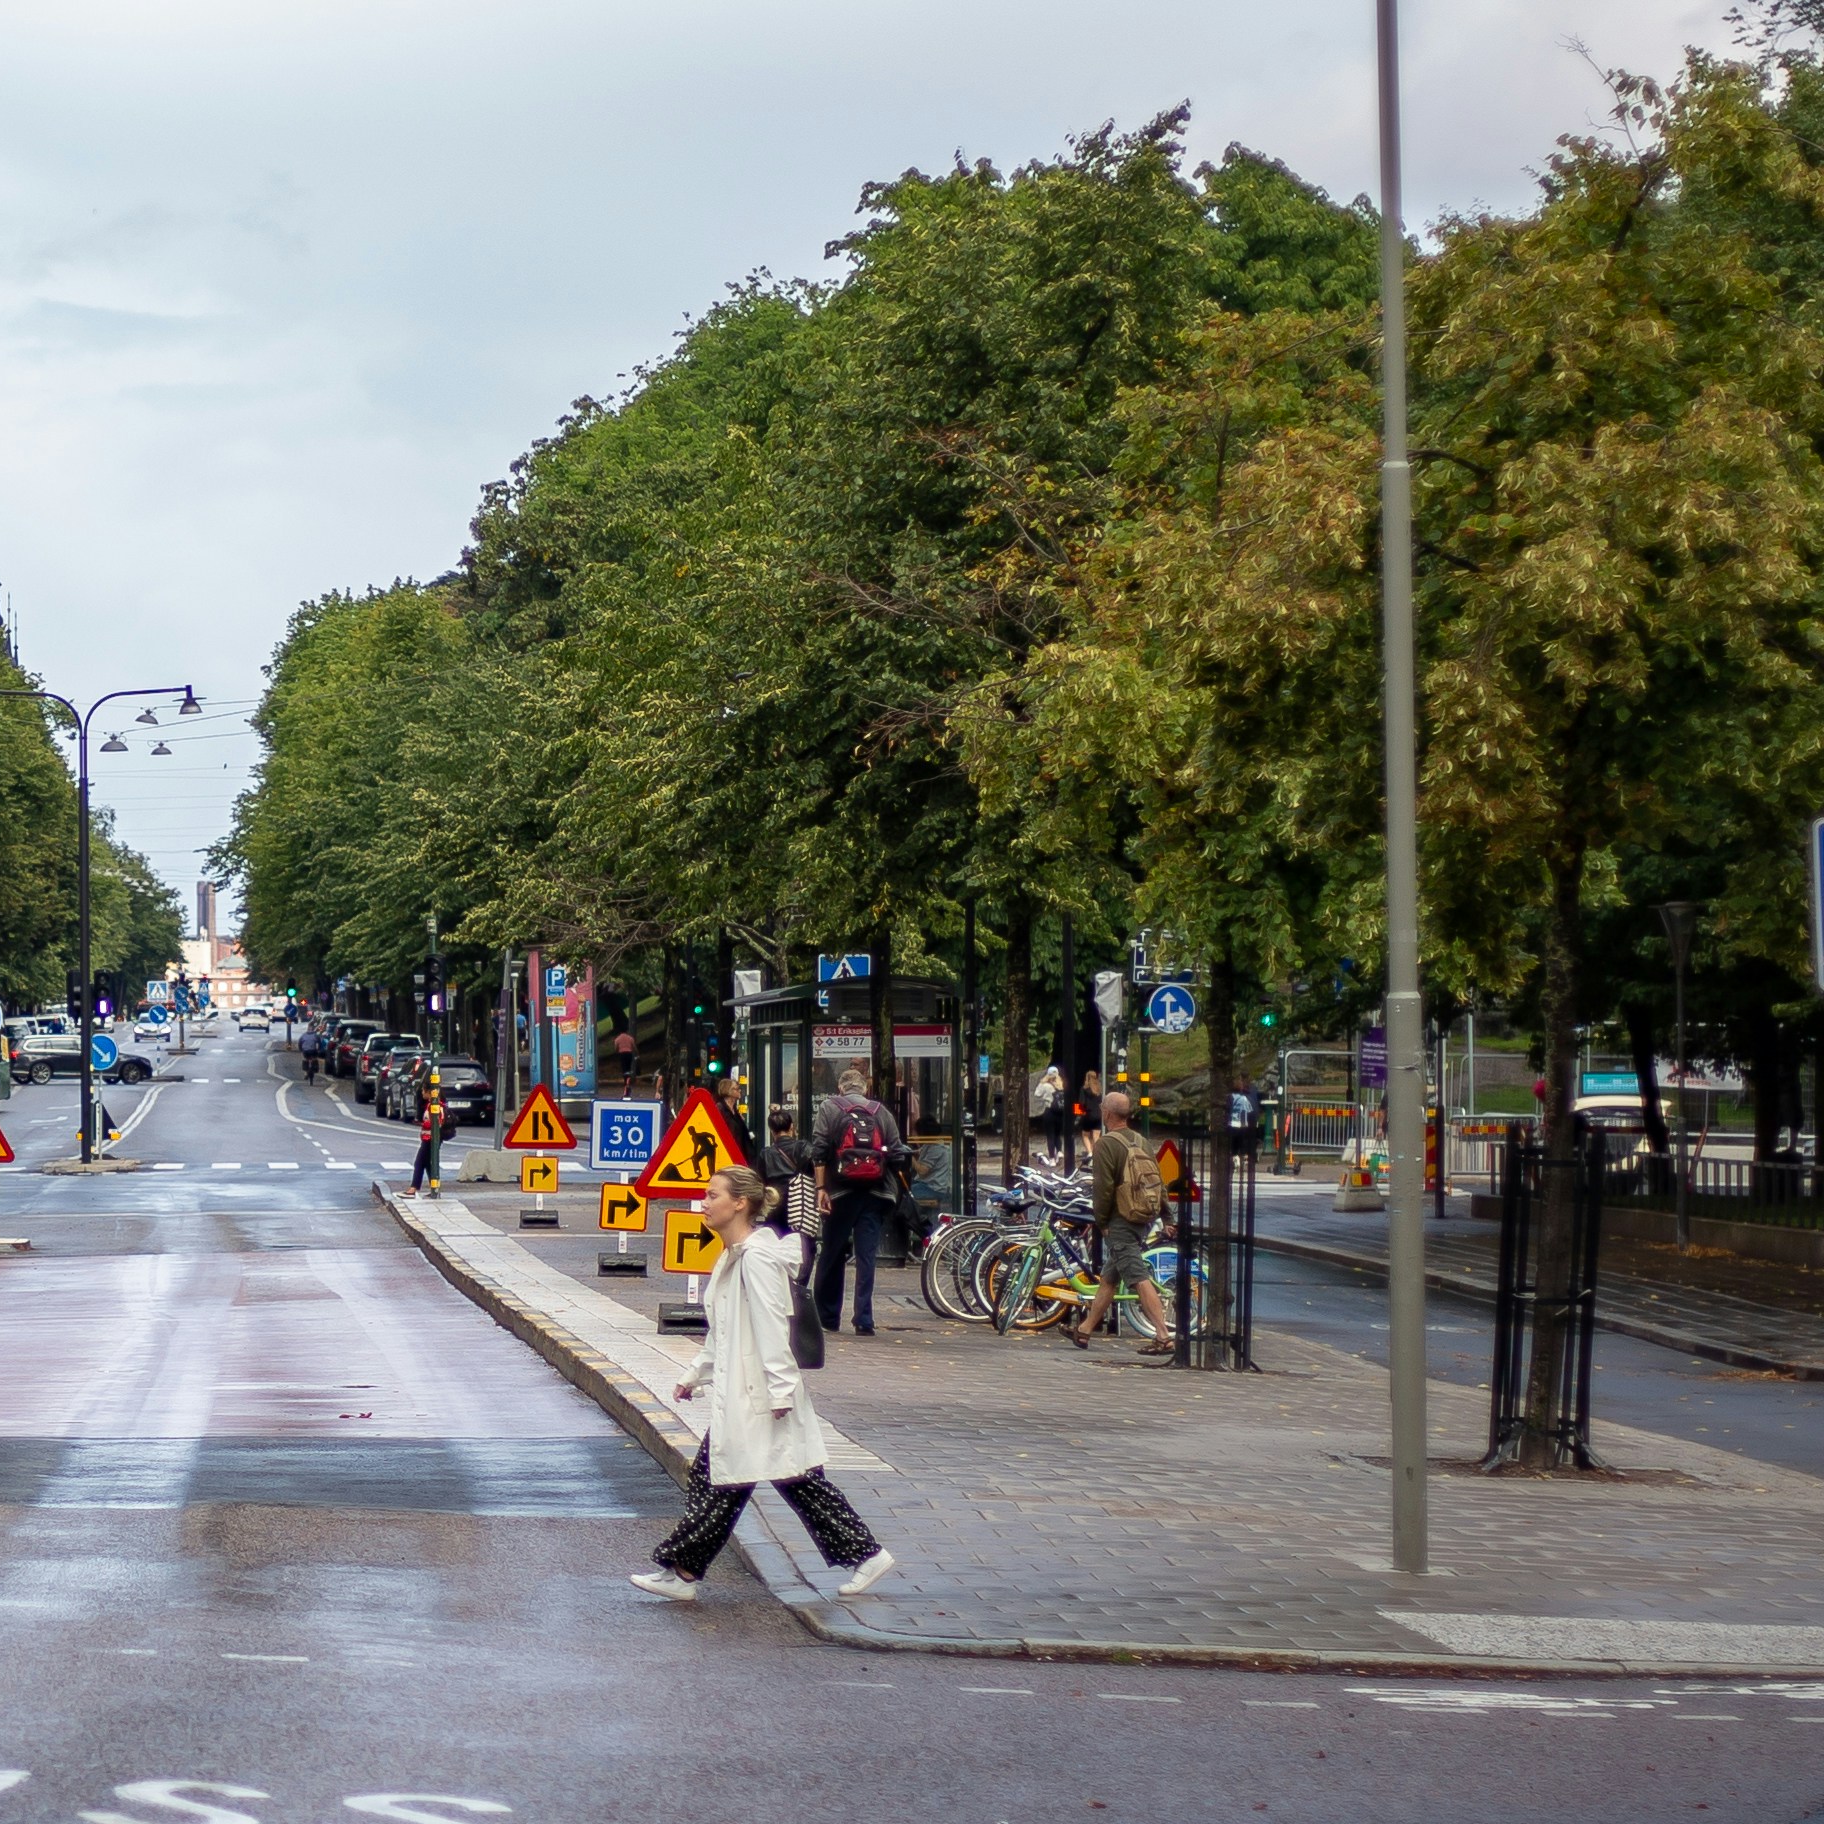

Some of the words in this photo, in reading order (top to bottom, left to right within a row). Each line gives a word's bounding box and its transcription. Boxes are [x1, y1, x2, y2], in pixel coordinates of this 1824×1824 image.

[551, 971, 562, 986] P
[837, 1037, 850, 1046] 58
[853, 1037, 865, 1046] 77
[936, 1037, 949, 1045] 94
[614, 1115, 639, 1123] max
[609, 1126, 644, 1145] 30
[603, 1148, 648, 1158] km/tim
